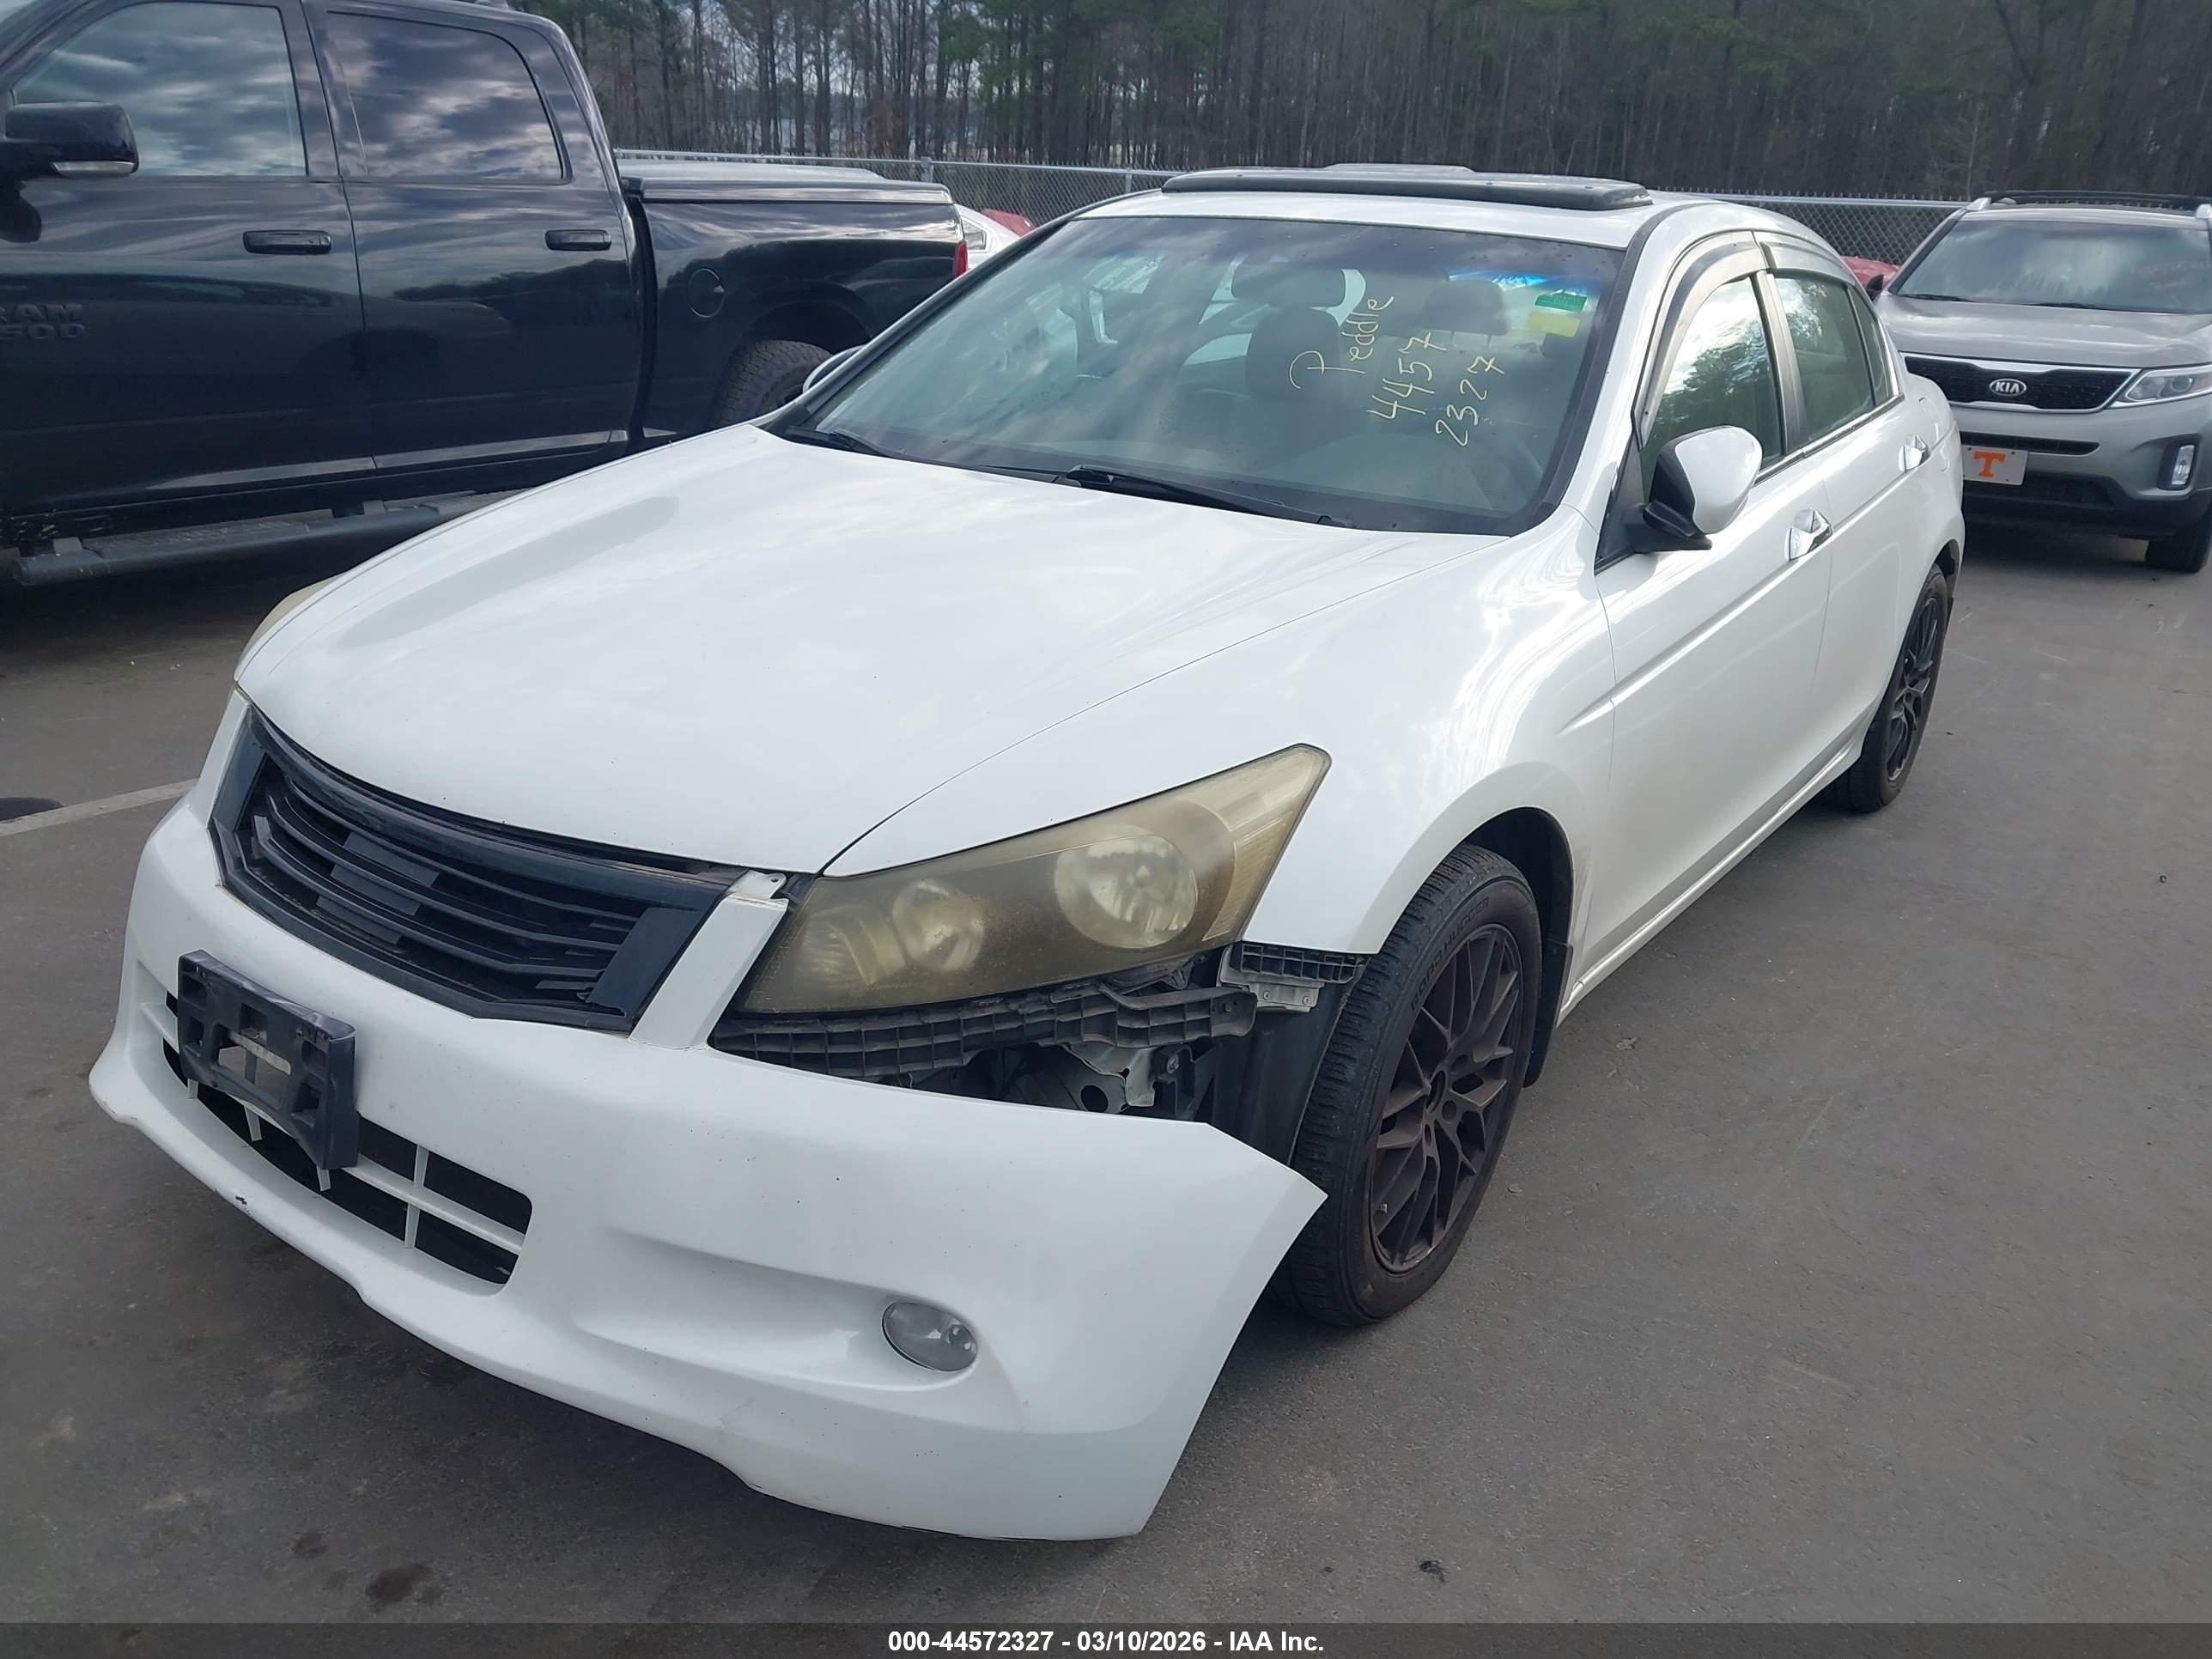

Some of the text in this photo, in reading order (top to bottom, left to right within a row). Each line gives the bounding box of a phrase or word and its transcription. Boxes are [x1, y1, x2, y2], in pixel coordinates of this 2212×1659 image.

[1365, 331, 1447, 419] 4457
[1435, 355, 1505, 447] 2327
[1995, 381, 2020, 393] KIA
[1973, 451, 2006, 477] T
